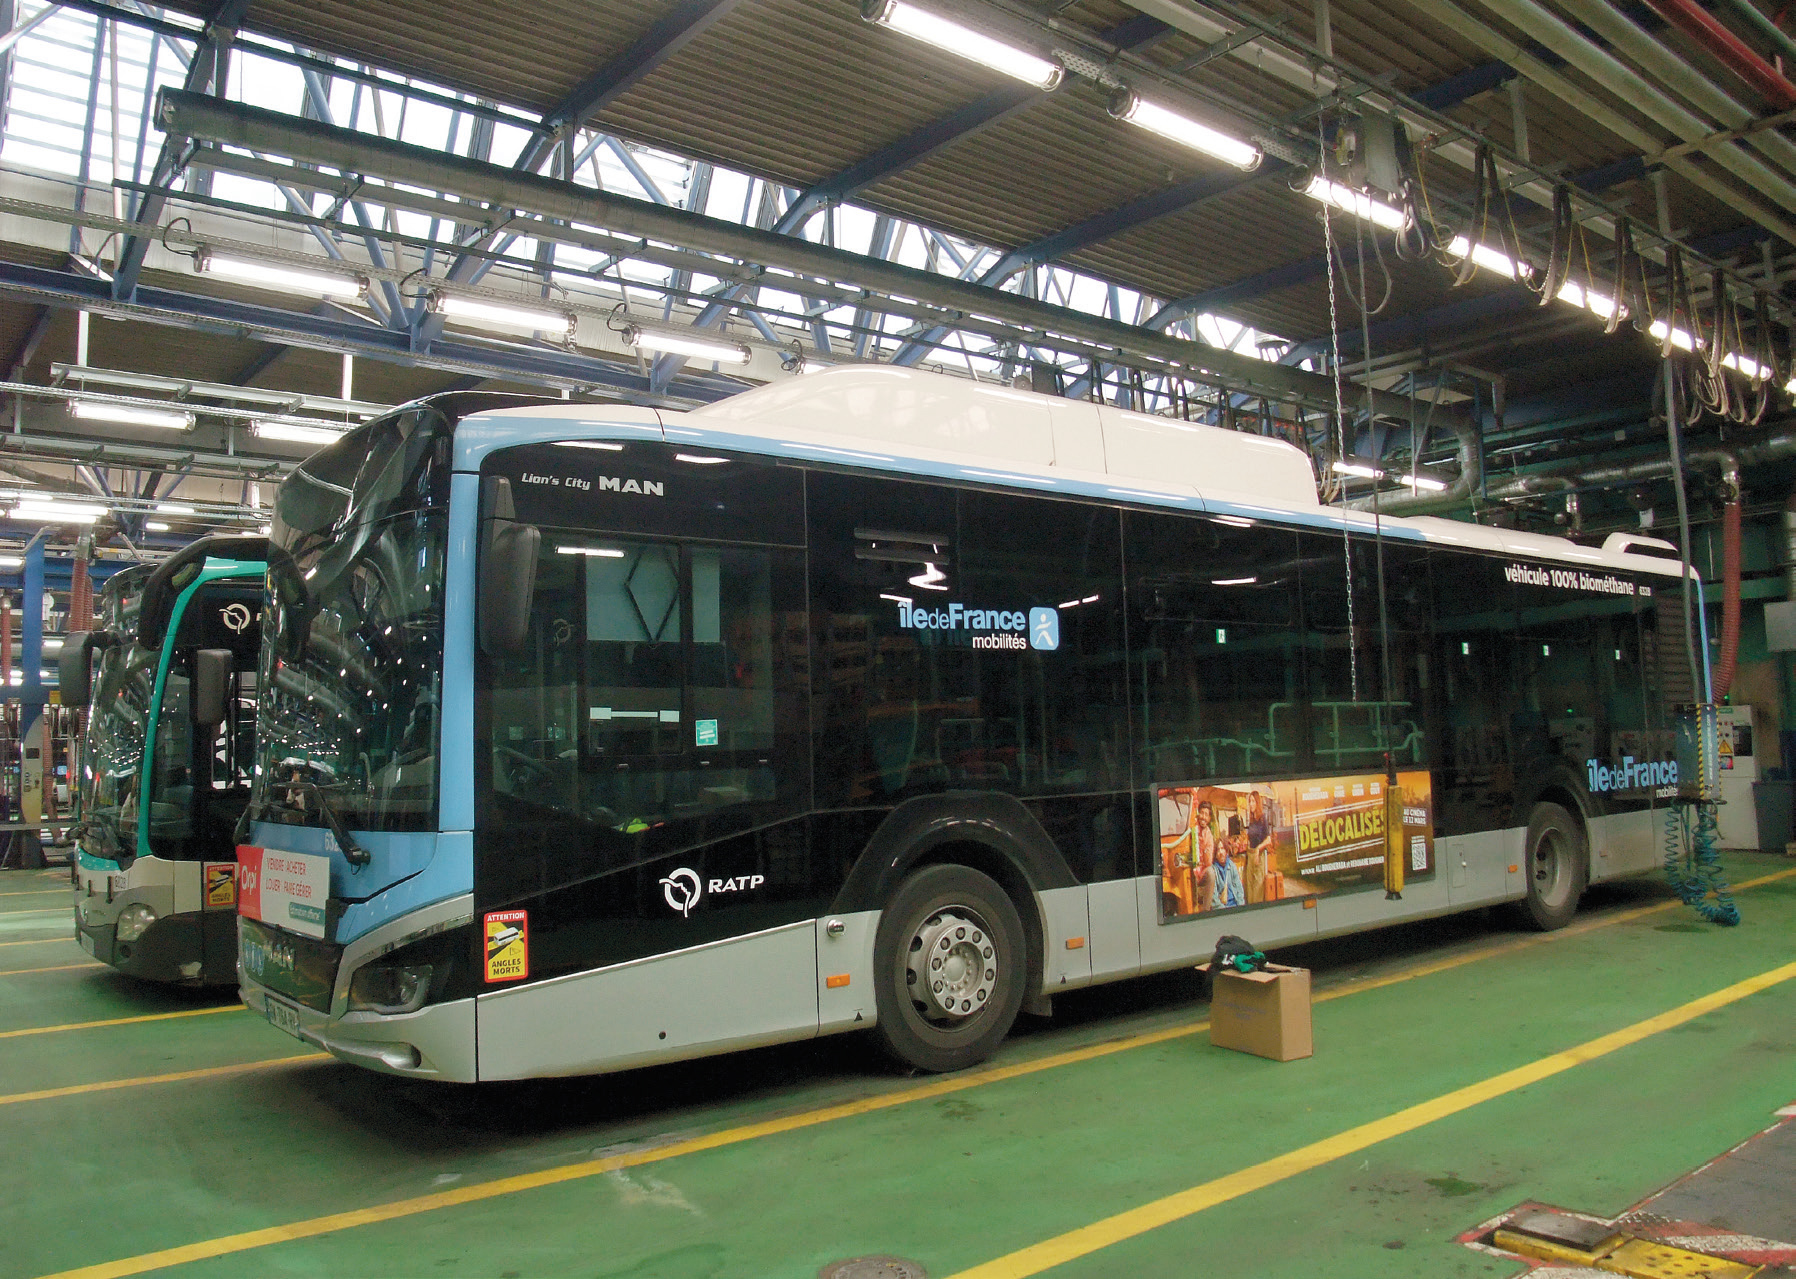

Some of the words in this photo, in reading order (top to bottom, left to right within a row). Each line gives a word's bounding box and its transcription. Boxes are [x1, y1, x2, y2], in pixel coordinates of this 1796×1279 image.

[521, 472, 560, 486] Lion's
[565, 477, 591, 491] City
[599, 475, 664, 497] MAN
[1504, 563, 1549, 586] véhicule
[1550, 569, 1578, 589] 100%
[1580, 572, 1634, 595] biométhane
[972, 632, 1027, 650] mobilités
[241, 865, 257, 896] Orpi
[708, 874, 765, 894] RATP
[487, 911, 525, 922] ATTENTION
[491, 958, 522, 968] ANGLES
[493, 966, 521, 976] MORTS
